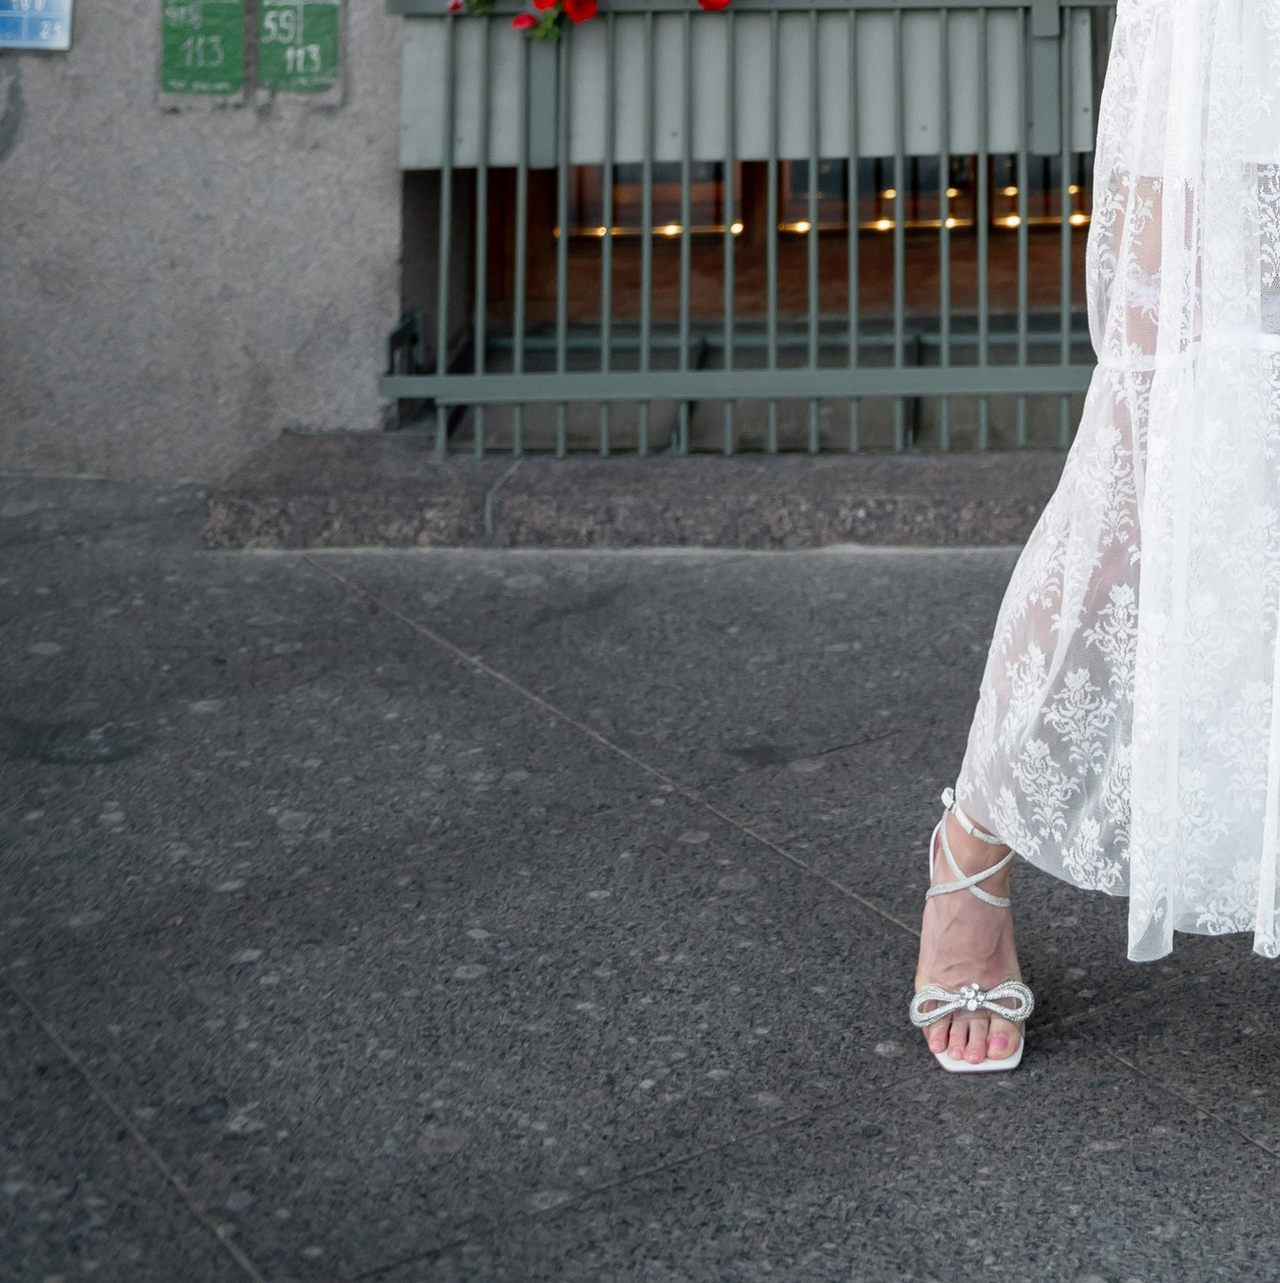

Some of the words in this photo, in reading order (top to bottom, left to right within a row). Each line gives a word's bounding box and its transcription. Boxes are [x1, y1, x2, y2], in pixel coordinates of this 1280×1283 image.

[262, 9, 295, 44] 59
[181, 35, 224, 66] 113
[286, 44, 321, 73] 113
